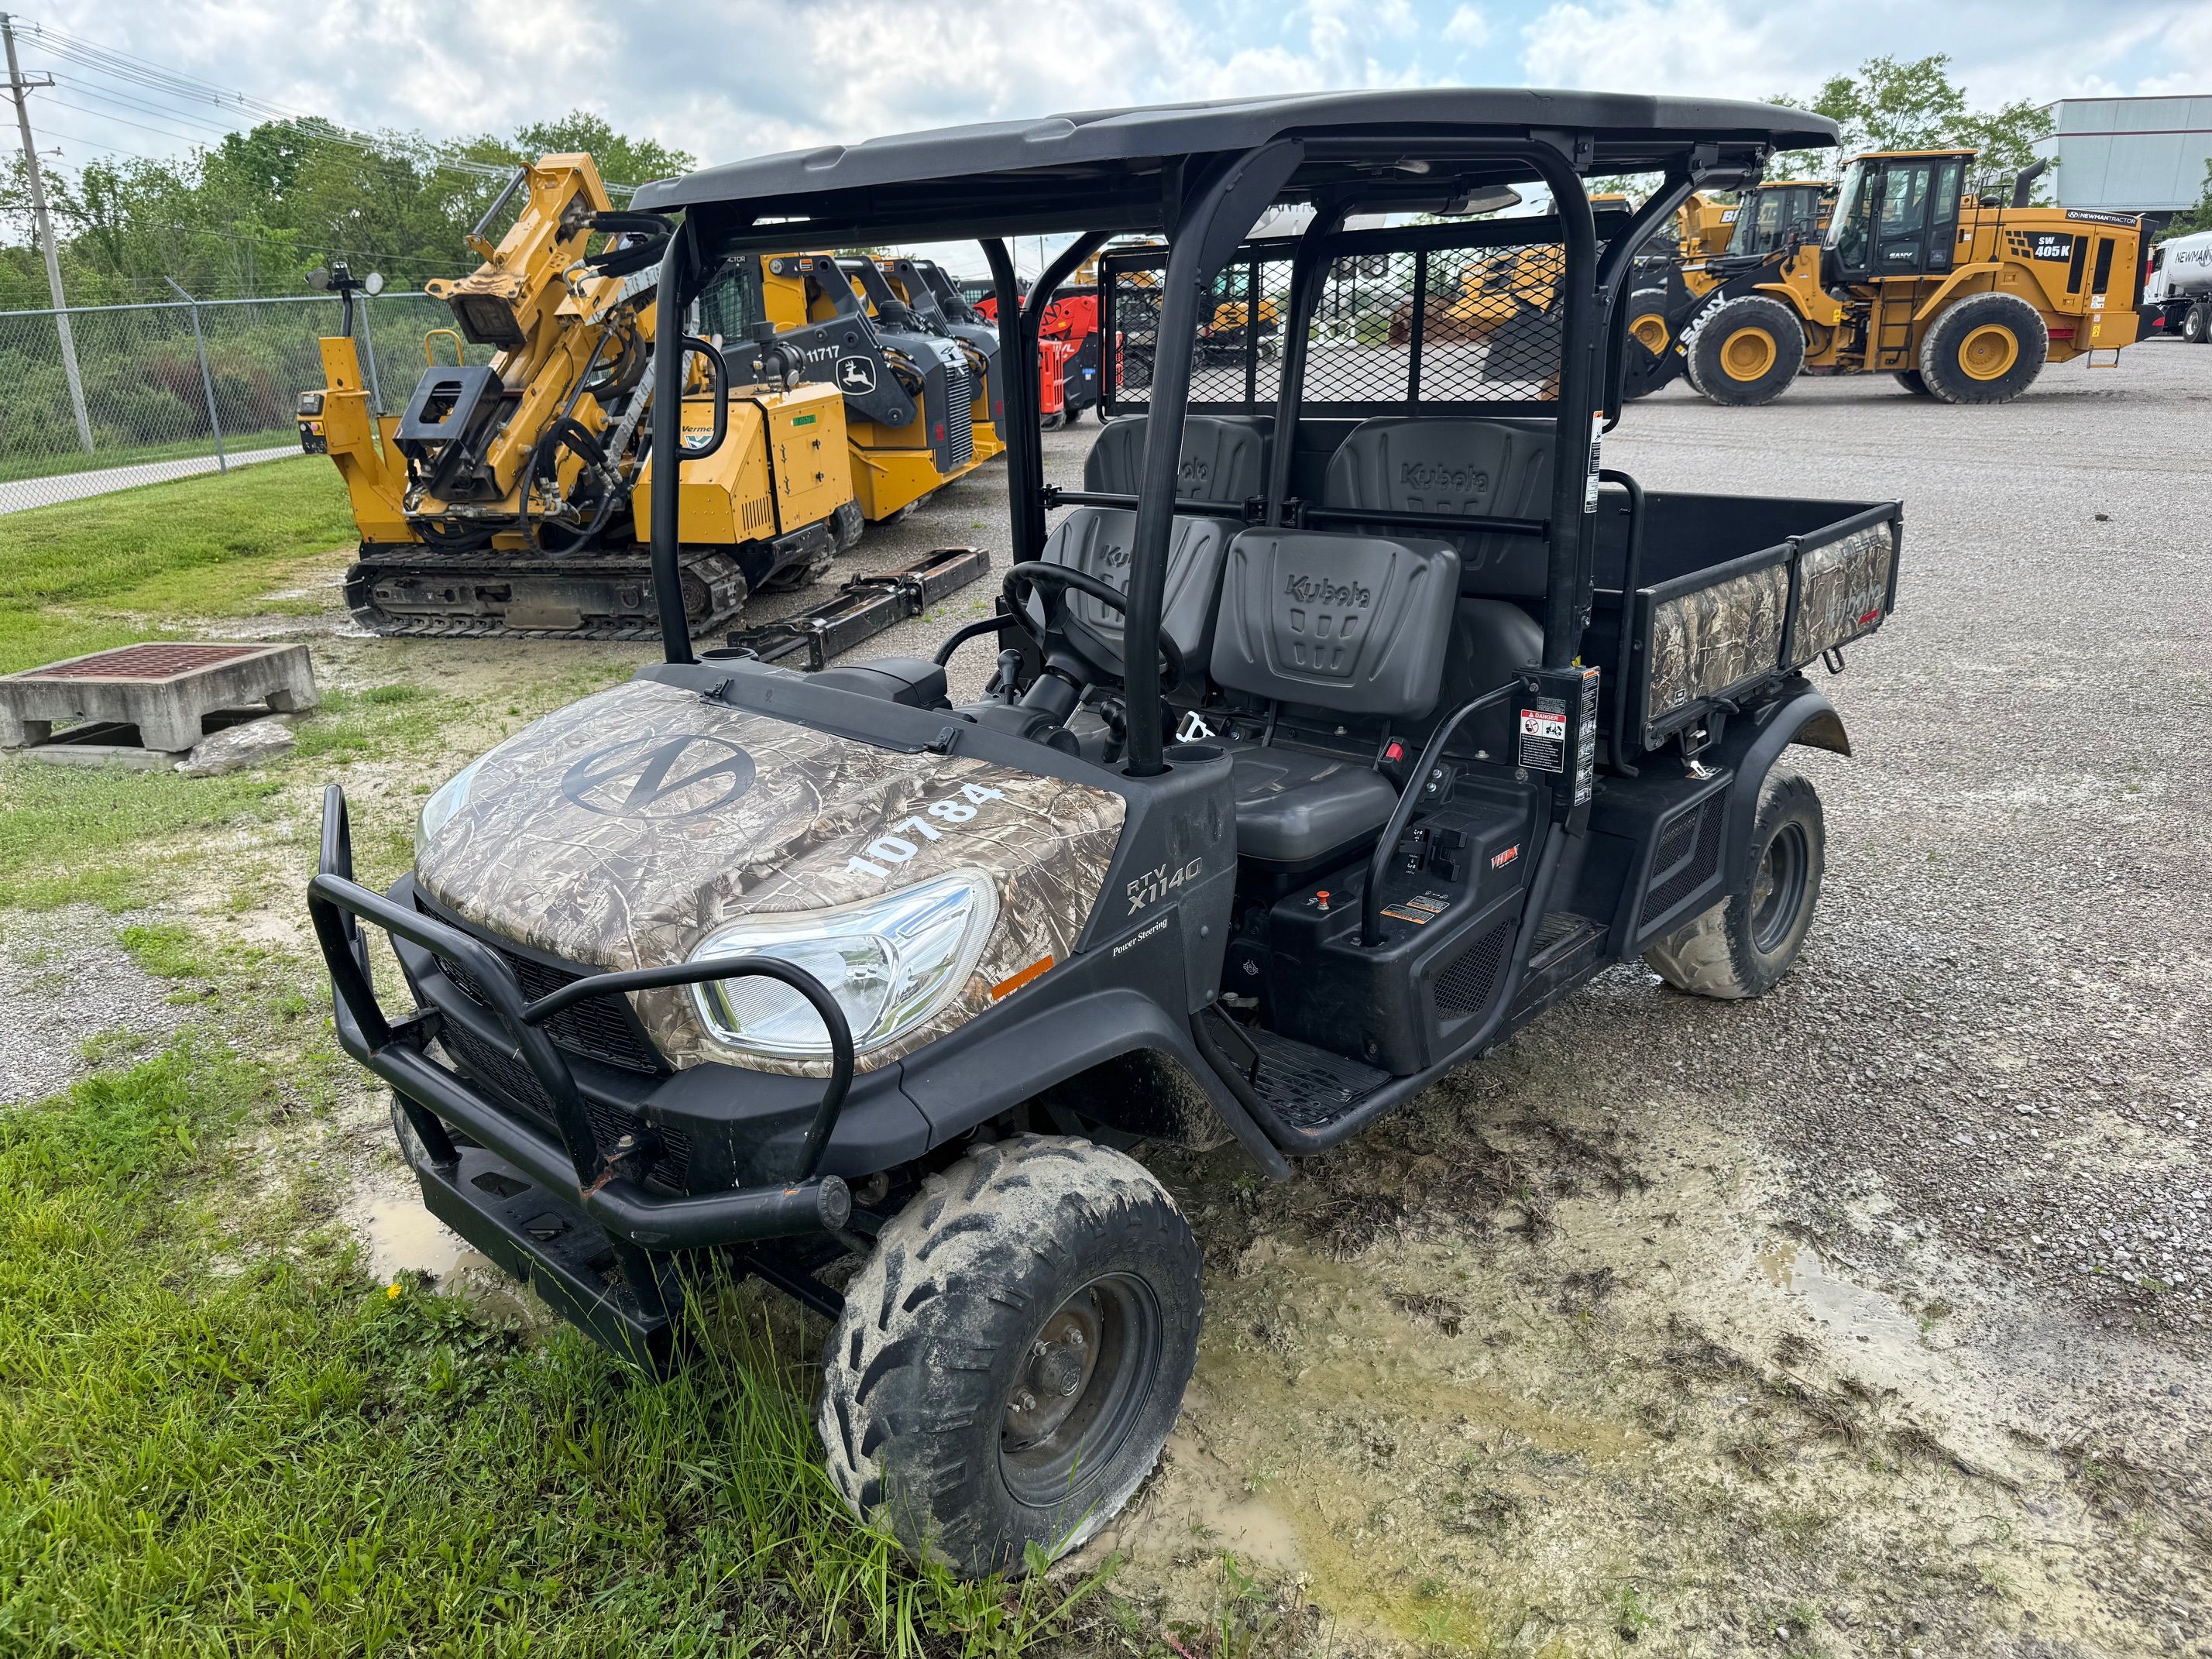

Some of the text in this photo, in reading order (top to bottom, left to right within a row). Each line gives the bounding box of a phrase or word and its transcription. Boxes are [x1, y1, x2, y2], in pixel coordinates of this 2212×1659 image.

[2039, 236, 2055, 246] SW
[2175, 249, 2210, 264] NEWMAN
[1679, 290, 1726, 345] SANY
[806, 345, 840, 363] 11717
[1400, 462, 1488, 493] Kubota
[1284, 574, 1371, 610] Kubota
[1534, 713, 1558, 722] DANGER
[843, 782, 1006, 879] 10784
[1127, 857, 1203, 916] X1140
[1112, 919, 1168, 957] Power Steering
